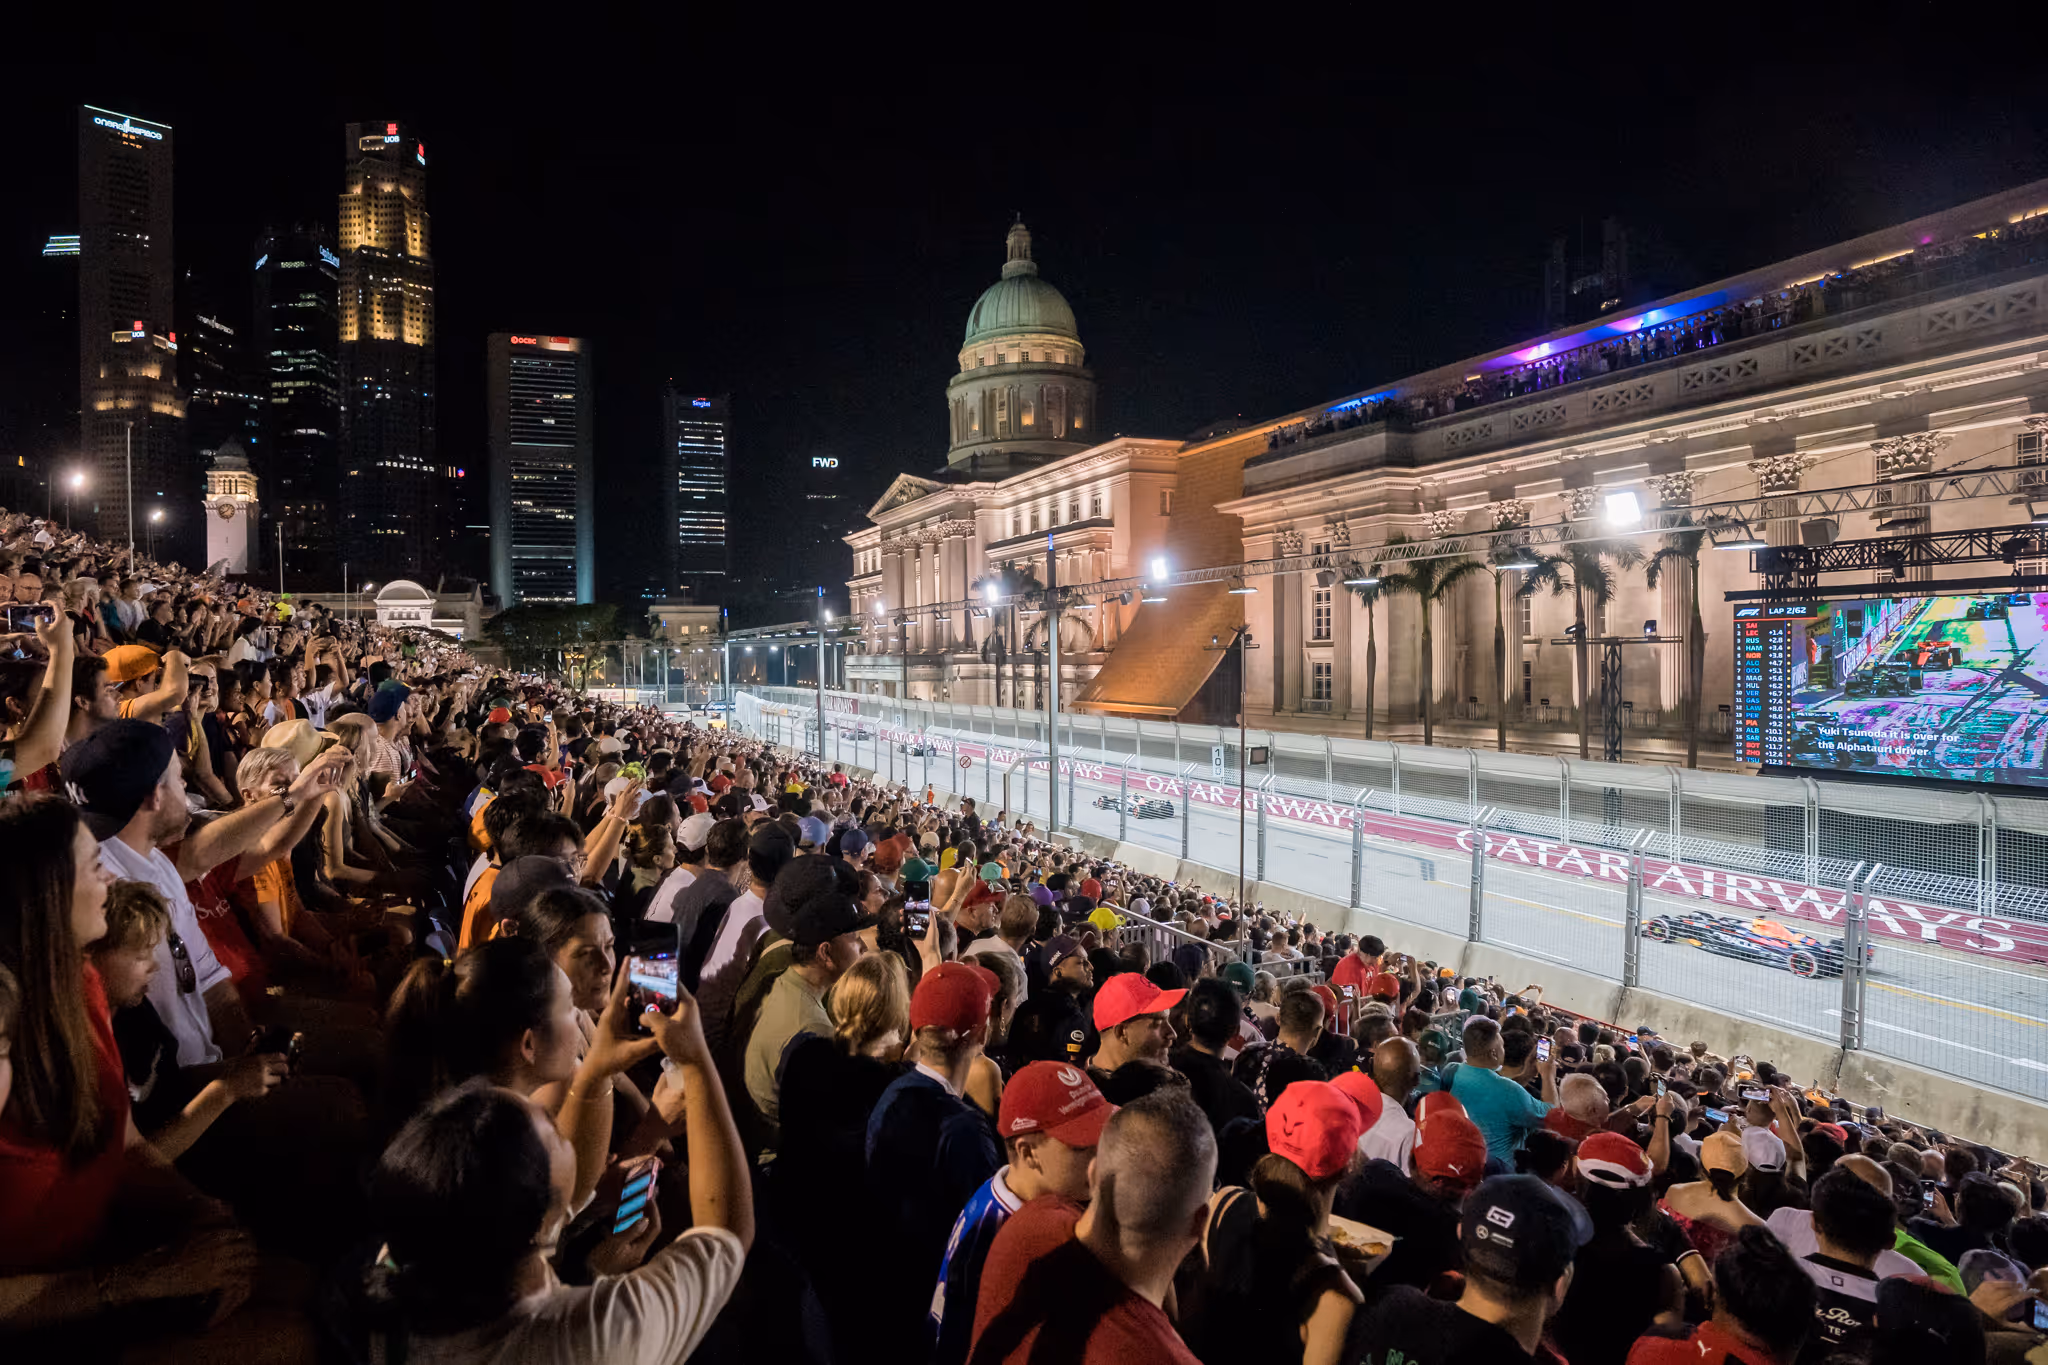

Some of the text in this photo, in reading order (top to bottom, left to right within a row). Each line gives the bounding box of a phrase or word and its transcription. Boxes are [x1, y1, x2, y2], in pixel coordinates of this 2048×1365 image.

[812, 457, 838, 468] FWD
[1786, 606, 1806, 614] 2/62
[887, 730, 915, 744] QATAR
[1818, 726, 1840, 735] Yuki
[1842, 728, 1887, 738] Tsunoda
[1889, 730, 1898, 739] it
[1901, 731, 1910, 740] is
[1941, 733, 1960, 742] for
[1836, 742, 1892, 754] Alphatauri
[1895, 746, 1929, 756] driver
[1033, 760, 1103, 780] AIWAYS
[1456, 828, 2016, 952] QATAR AIRWAYS
